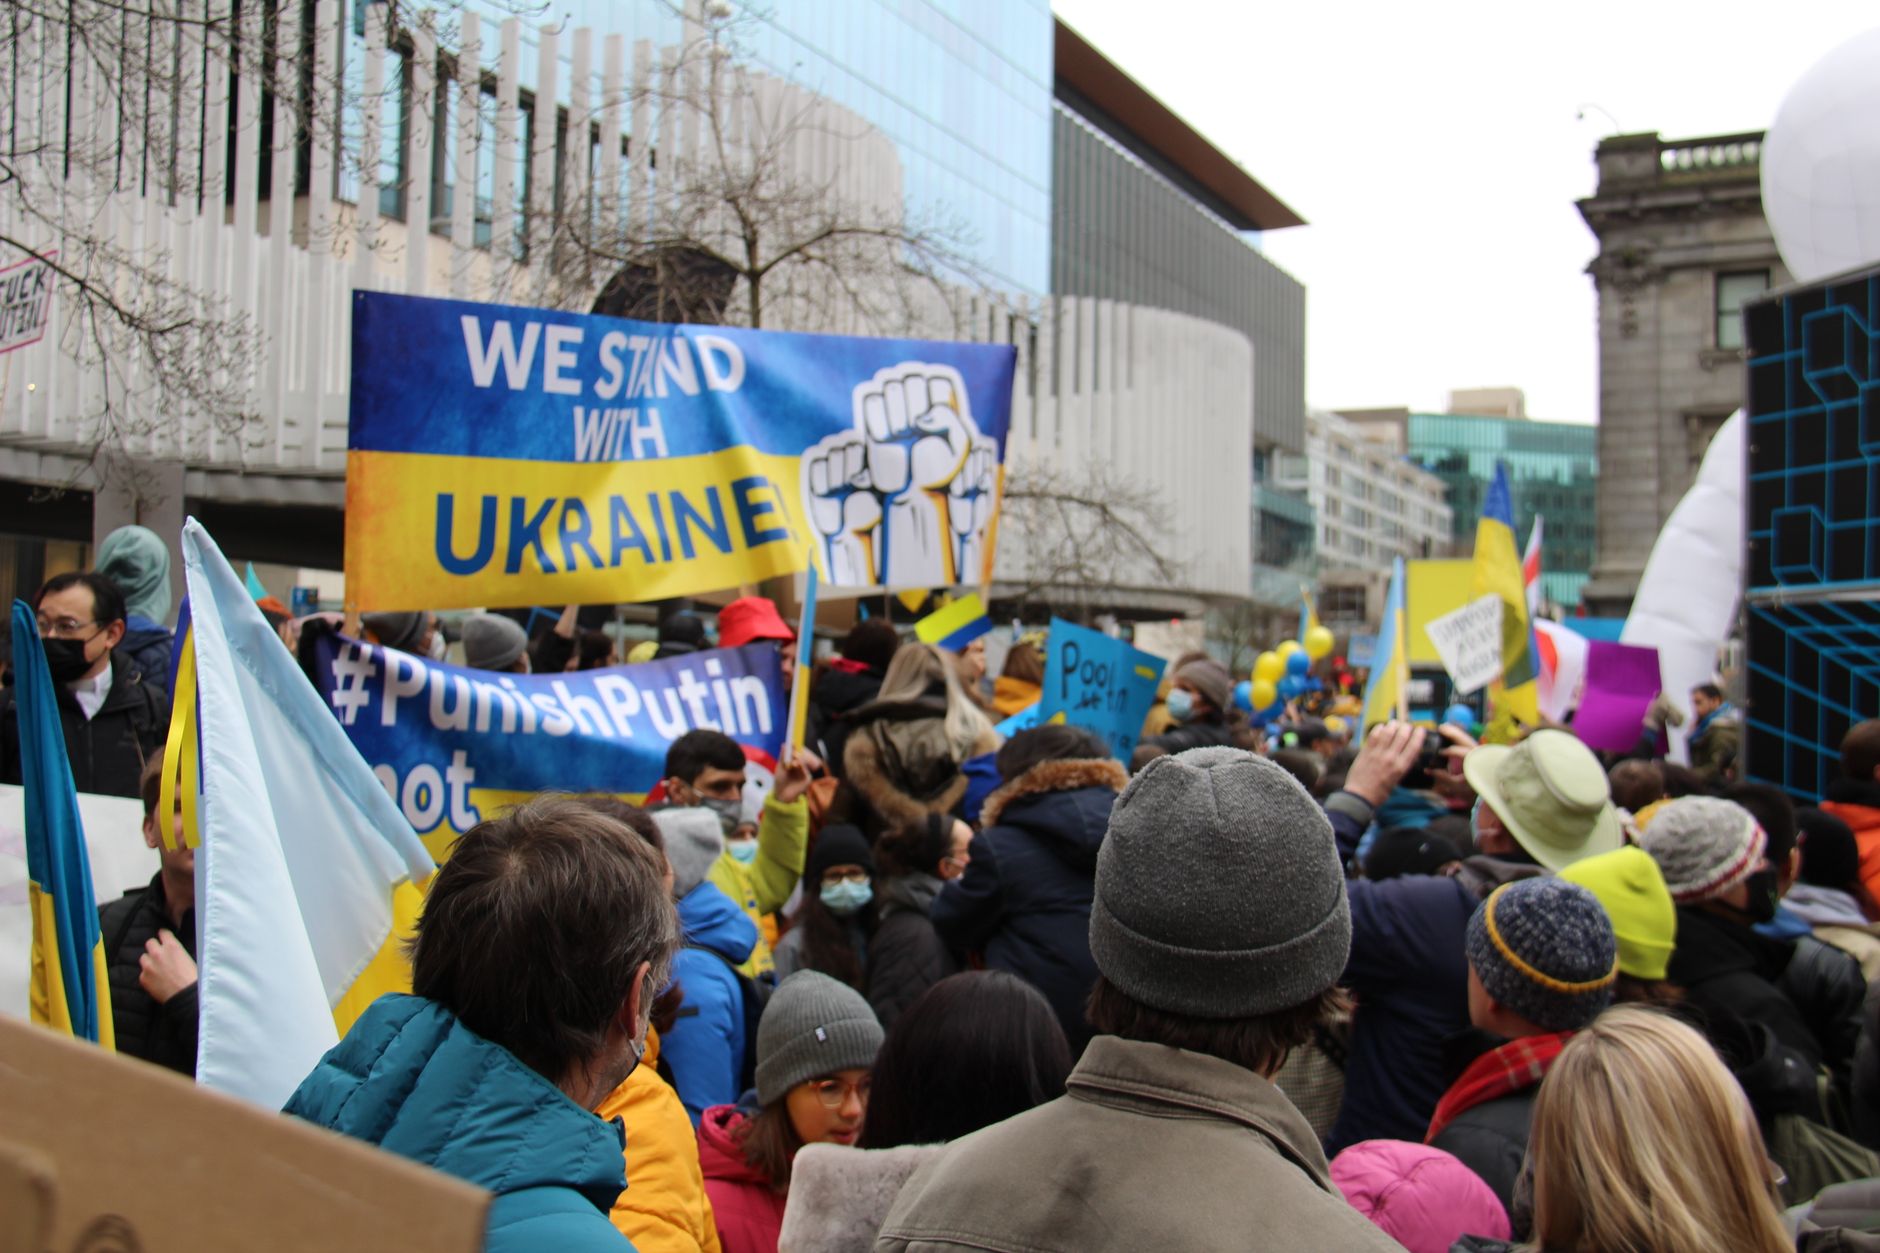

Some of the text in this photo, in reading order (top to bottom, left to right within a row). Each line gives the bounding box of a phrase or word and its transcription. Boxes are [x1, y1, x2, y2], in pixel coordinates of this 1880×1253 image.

[460, 315, 747, 401] WE STAND
[572, 405, 669, 462] WITH
[434, 474, 799, 577] UKRAINE!
[331, 643, 773, 740] #PunishPutin
